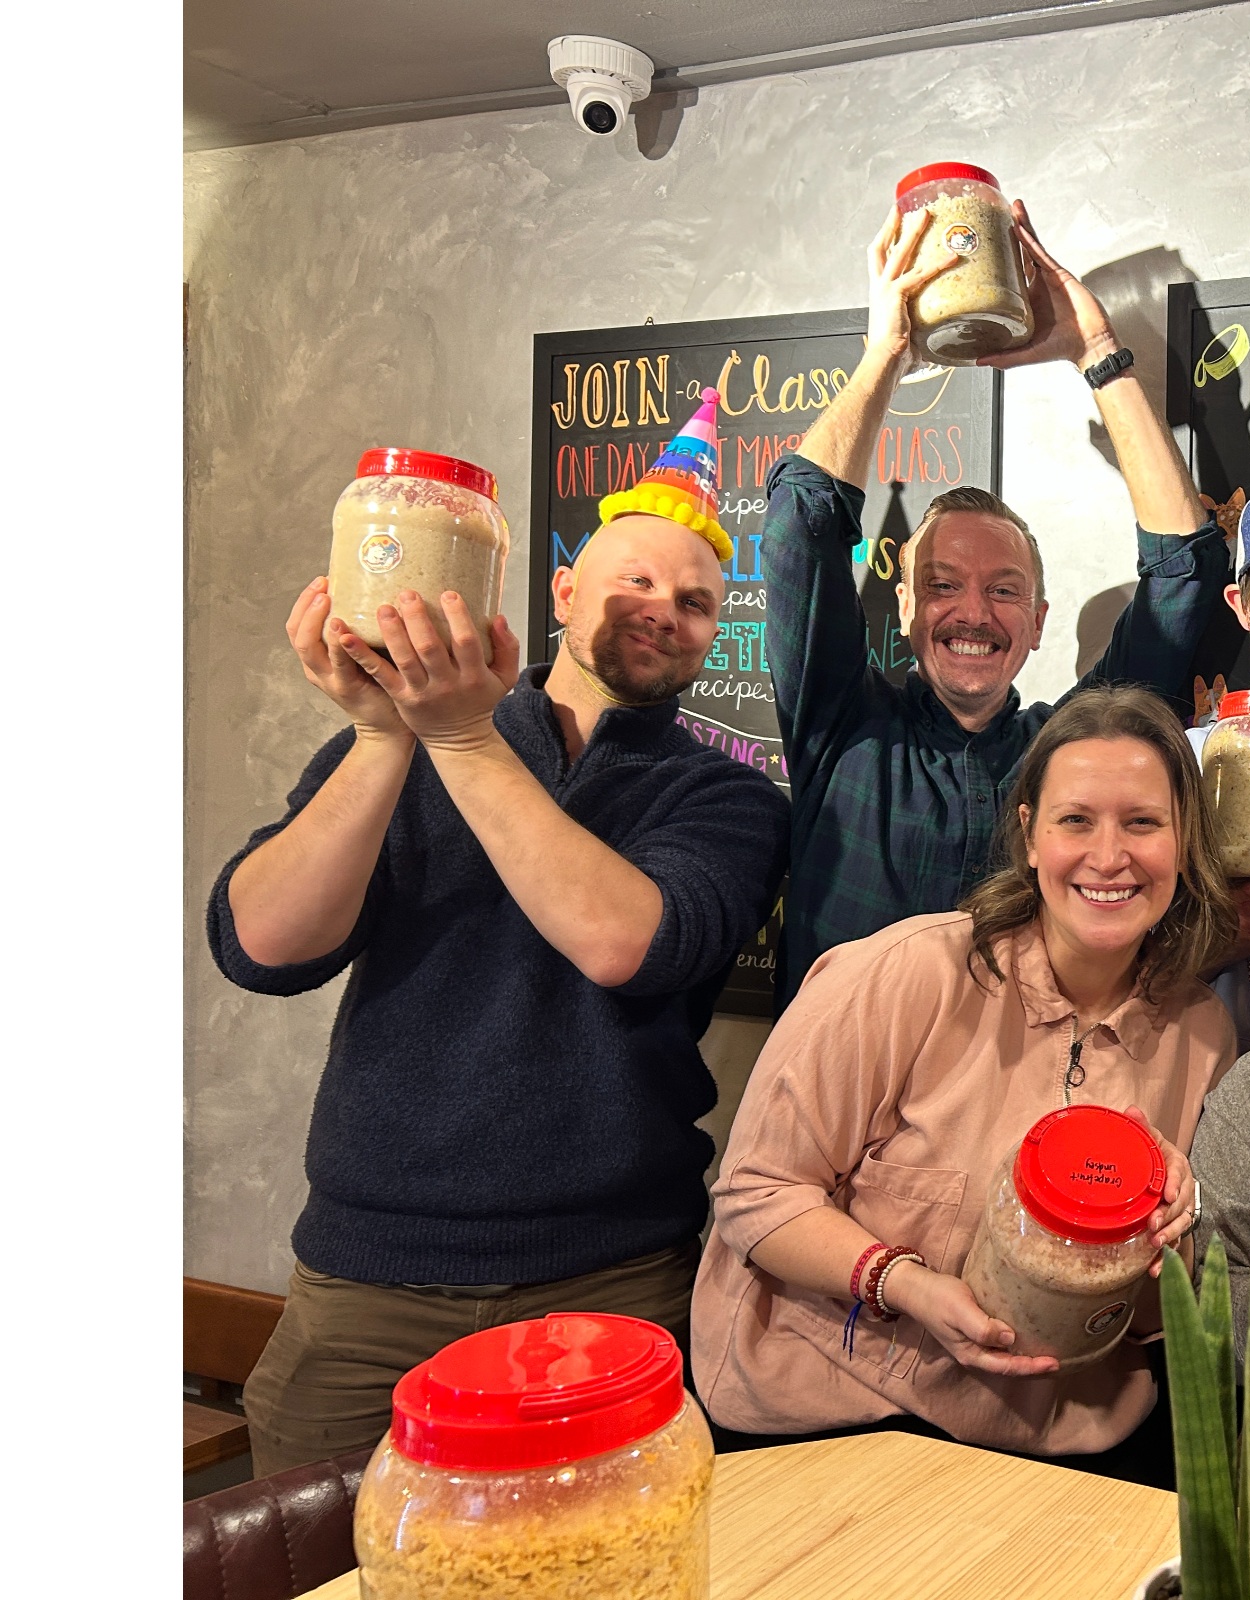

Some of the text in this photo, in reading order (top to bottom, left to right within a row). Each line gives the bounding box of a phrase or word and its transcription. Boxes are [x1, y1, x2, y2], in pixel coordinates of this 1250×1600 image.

[551, 354, 671, 430] JOIN
[556, 444, 602, 499] ONE
[608, 442, 650, 494] DAY
[877, 426, 962, 484] CLASS
[676, 716, 767, 774] STING
[1070, 1171, 1122, 1188] Grapefruit
